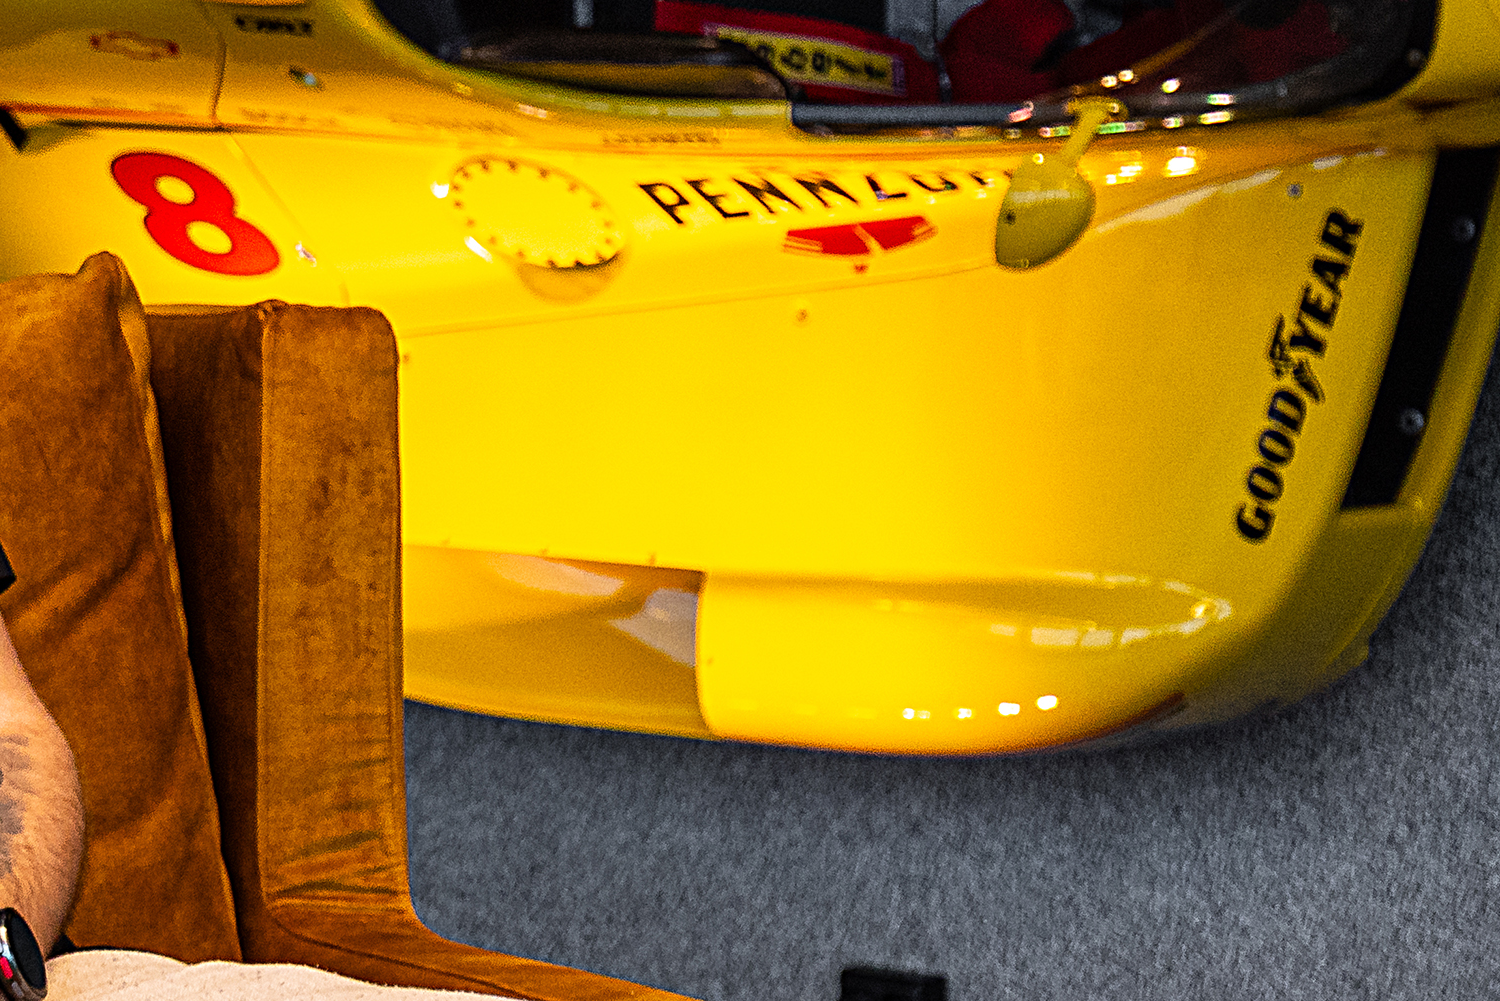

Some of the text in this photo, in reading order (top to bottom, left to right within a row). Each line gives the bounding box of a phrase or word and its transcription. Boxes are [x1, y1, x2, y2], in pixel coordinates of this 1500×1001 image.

[110, 151, 281, 277] 8
[635, 170, 1013, 226] PENNZO
[1234, 206, 1365, 544] GOODYEAR
